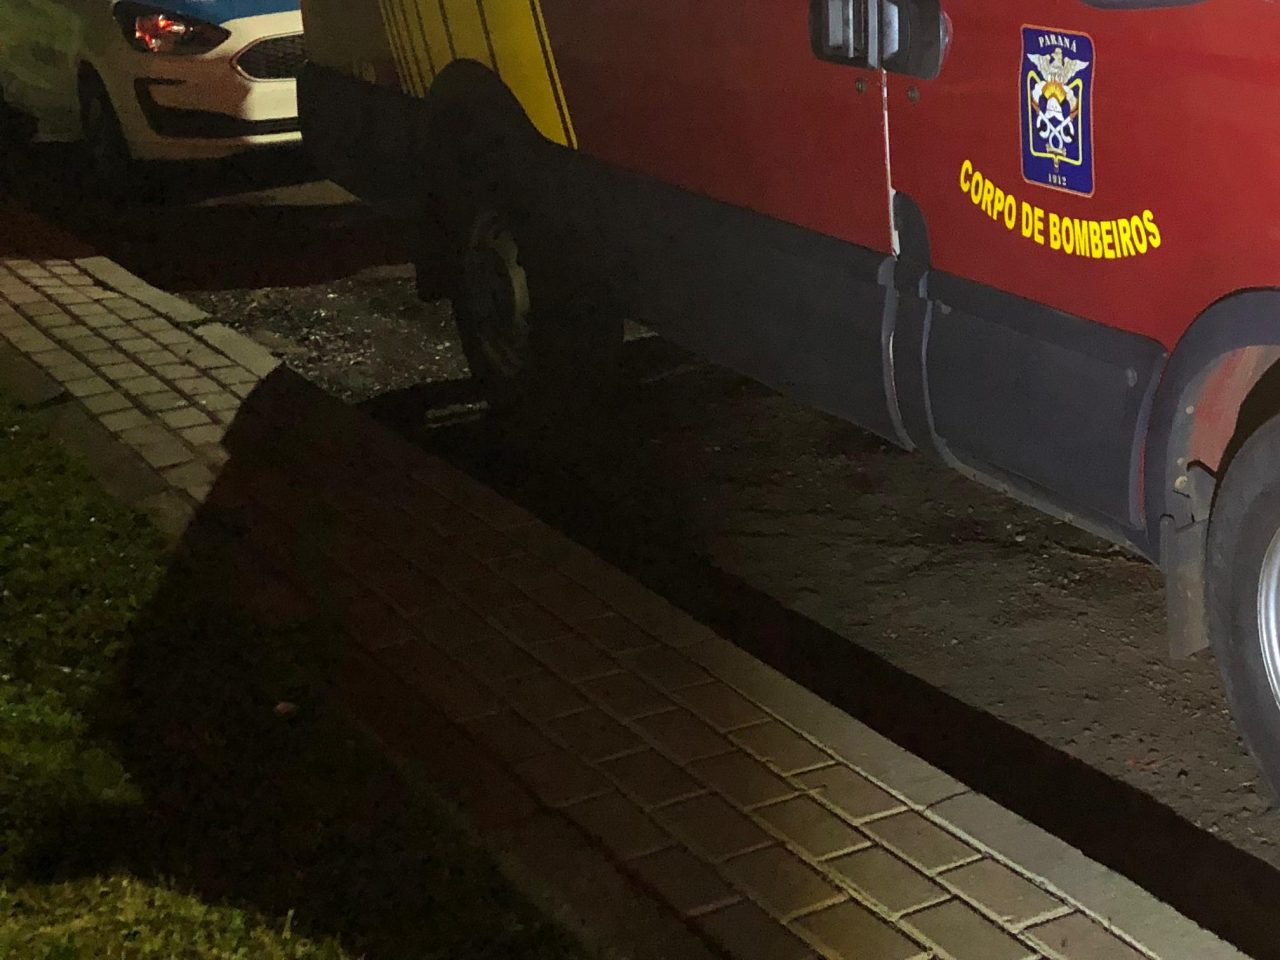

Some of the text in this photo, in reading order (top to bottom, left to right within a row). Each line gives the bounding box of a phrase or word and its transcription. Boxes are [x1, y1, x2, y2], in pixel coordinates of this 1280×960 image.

[959, 159, 1162, 259] CORPO DE BOMBEIROS
